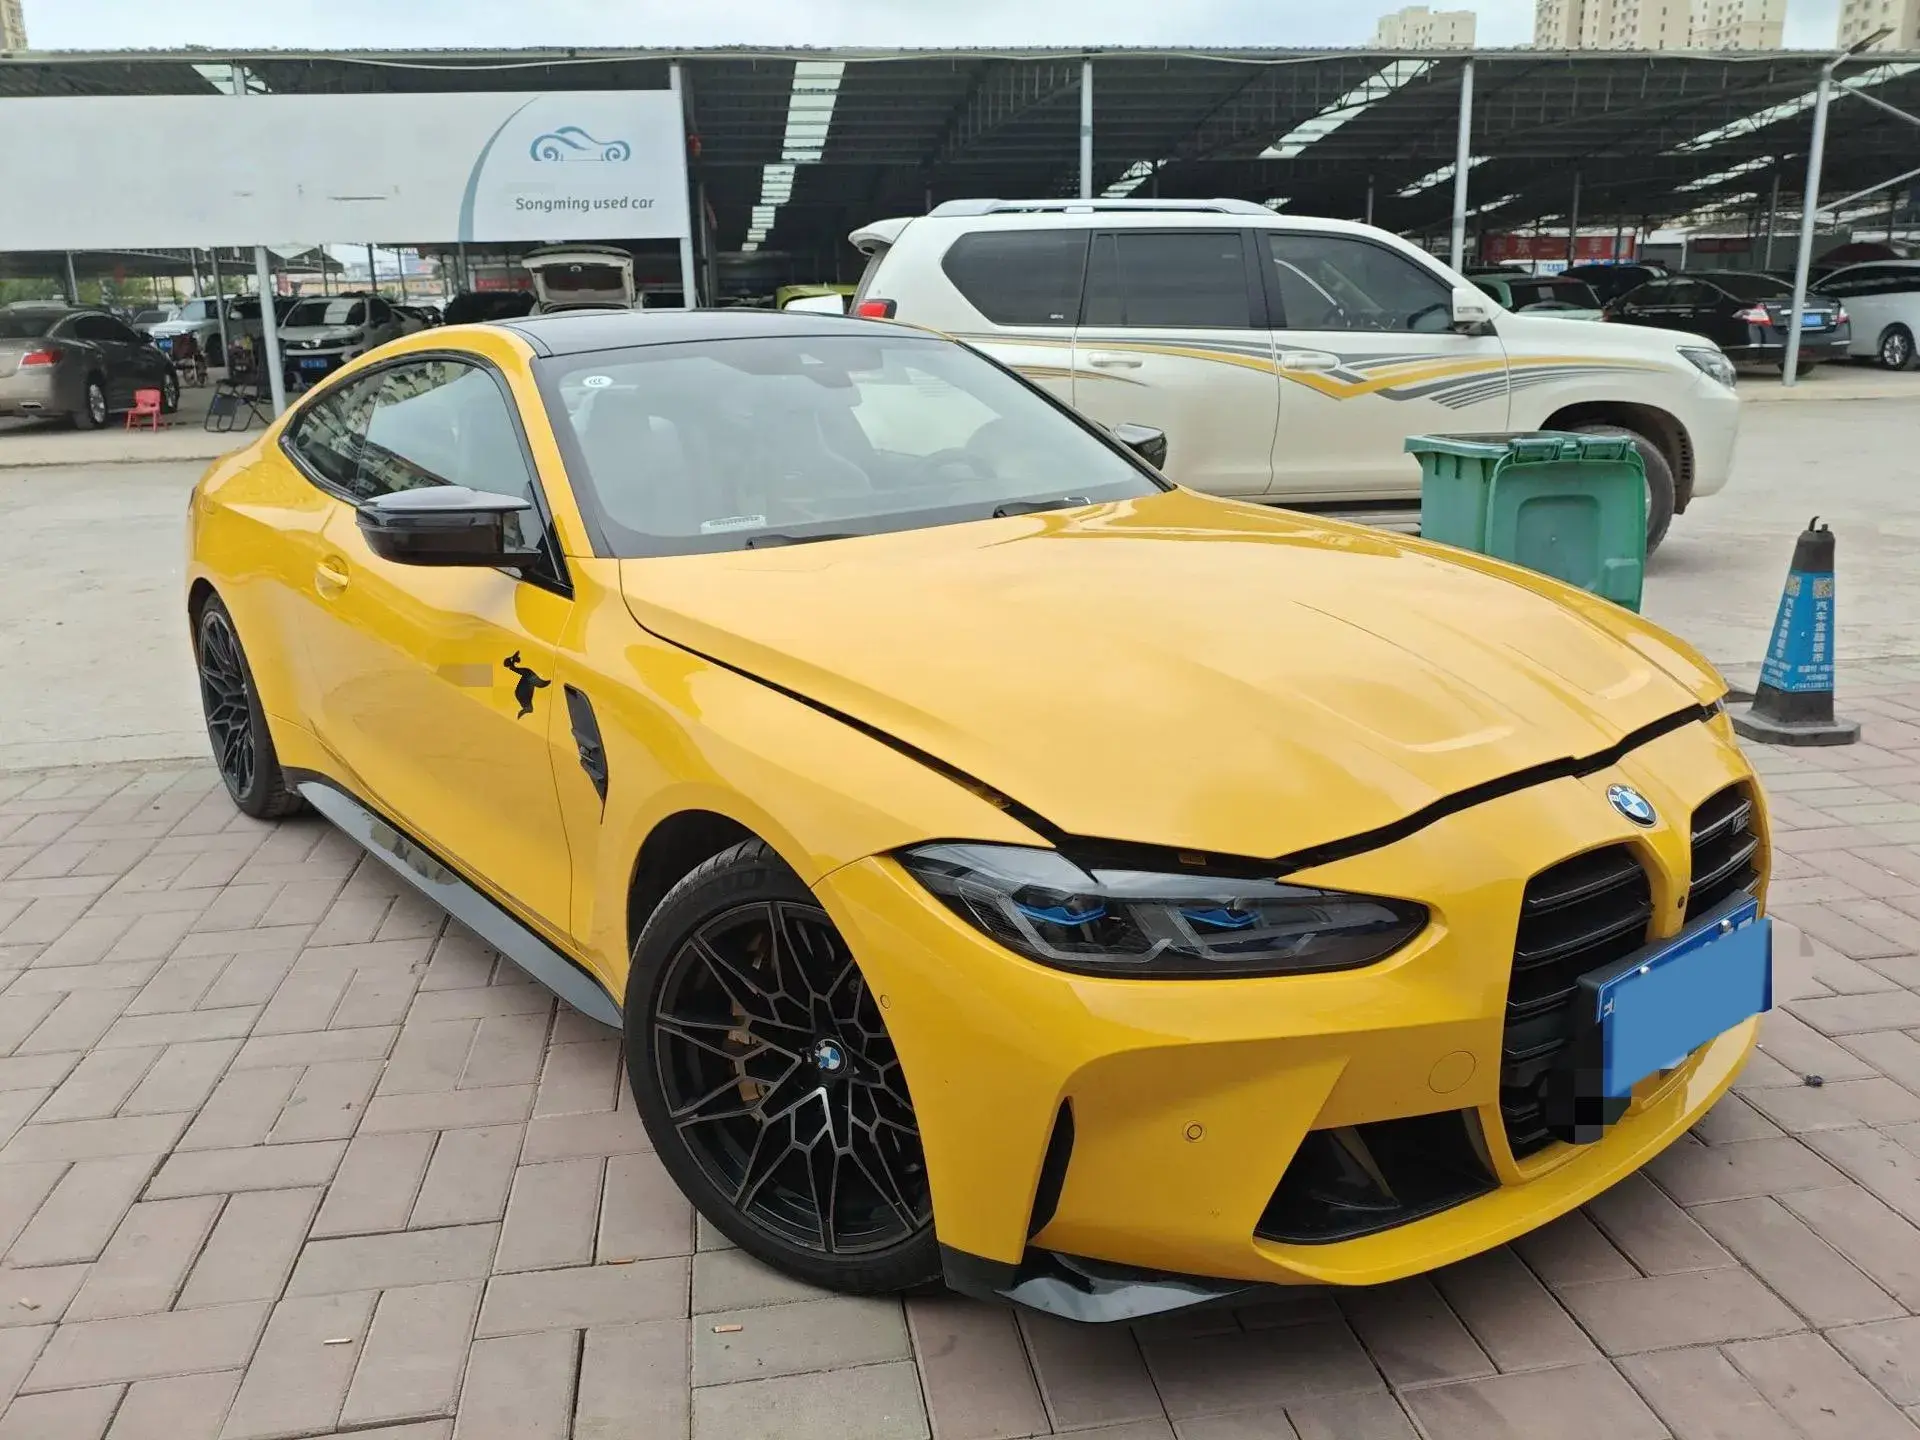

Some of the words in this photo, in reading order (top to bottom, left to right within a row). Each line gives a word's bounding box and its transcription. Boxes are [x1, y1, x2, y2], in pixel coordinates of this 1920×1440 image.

[515, 196, 590, 213] Songming
[594, 196, 628, 210] used
[631, 198, 655, 209] car
